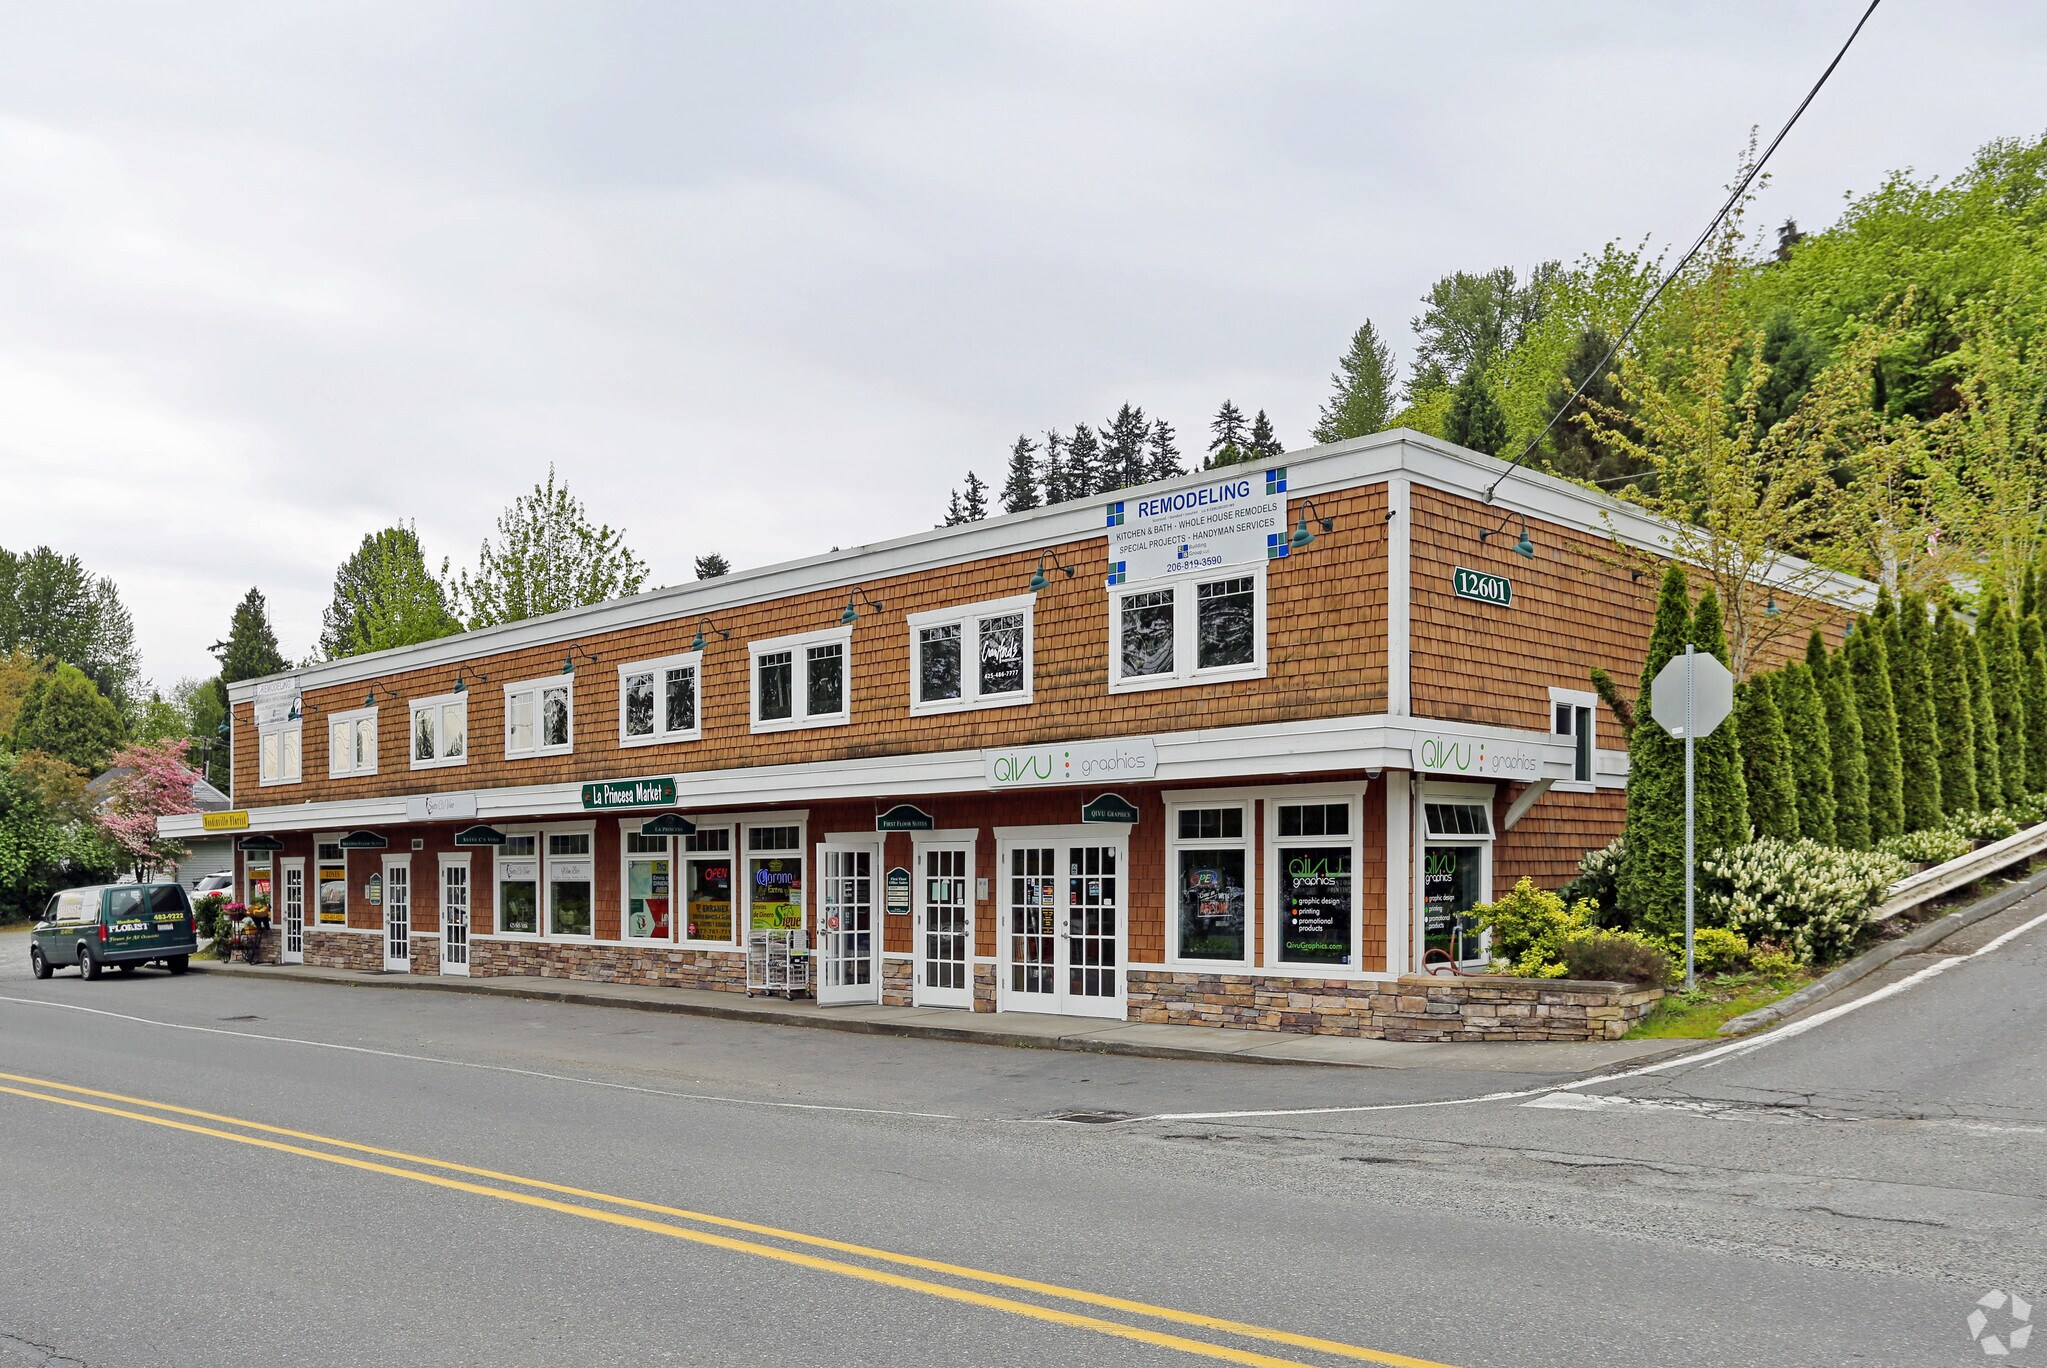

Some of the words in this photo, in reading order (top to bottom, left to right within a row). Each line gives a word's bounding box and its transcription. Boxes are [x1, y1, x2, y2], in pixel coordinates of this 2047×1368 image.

[1138, 481, 1250, 518] REMODELING
[1116, 528, 1146, 541] KITCHEN
[1147, 526, 1153, 535] &
[1154, 523, 1173, 534] BATH
[1178, 516, 1205, 529] WHOLE
[1206, 511, 1233, 525] HOUSE
[1235, 502, 1278, 517] REMODELS
[1119, 541, 1148, 554] SPECIAL
[1149, 535, 1186, 548] PROJECTS
[1192, 527, 1235, 540] HANDYMAN
[1236, 517, 1275, 533] SERVICES
[1166, 555, 1222, 573] 206-819-3590
[1460, 572, 1506, 601] 12601
[1081, 748, 1145, 777] graphics
[1492, 747, 1537, 773] graphics
[593, 786, 601, 805] La
[604, 784, 633, 805] Princesa
[635, 782, 662, 803] Market
[1091, 810, 1105, 818] QIVU
[1107, 810, 1131, 818] GRAPHICS
[705, 868, 728, 880] OPEN
[756, 868, 793, 886] Corona
[1293, 872, 1336, 888] graphics
[1425, 869, 1453, 885] graphics
[768, 885, 783, 894] Extra
[1298, 897, 1320, 906] graphic
[1320, 897, 1340, 906] design
[1428, 893, 1442, 902] graphic
[1443, 893, 1455, 902] design
[1298, 907, 1320, 916] printing
[1428, 905, 1443, 913] printing
[153, 913, 184, 921] 483-9222
[774, 904, 800, 930] Sigue
[1298, 917, 1333, 926] promotional
[109, 923, 148, 933] FLORIST
[1298, 924, 1323, 932] products
[1428, 921, 1444, 930] products
[1286, 941, 1343, 950] QivuGraphics.com
